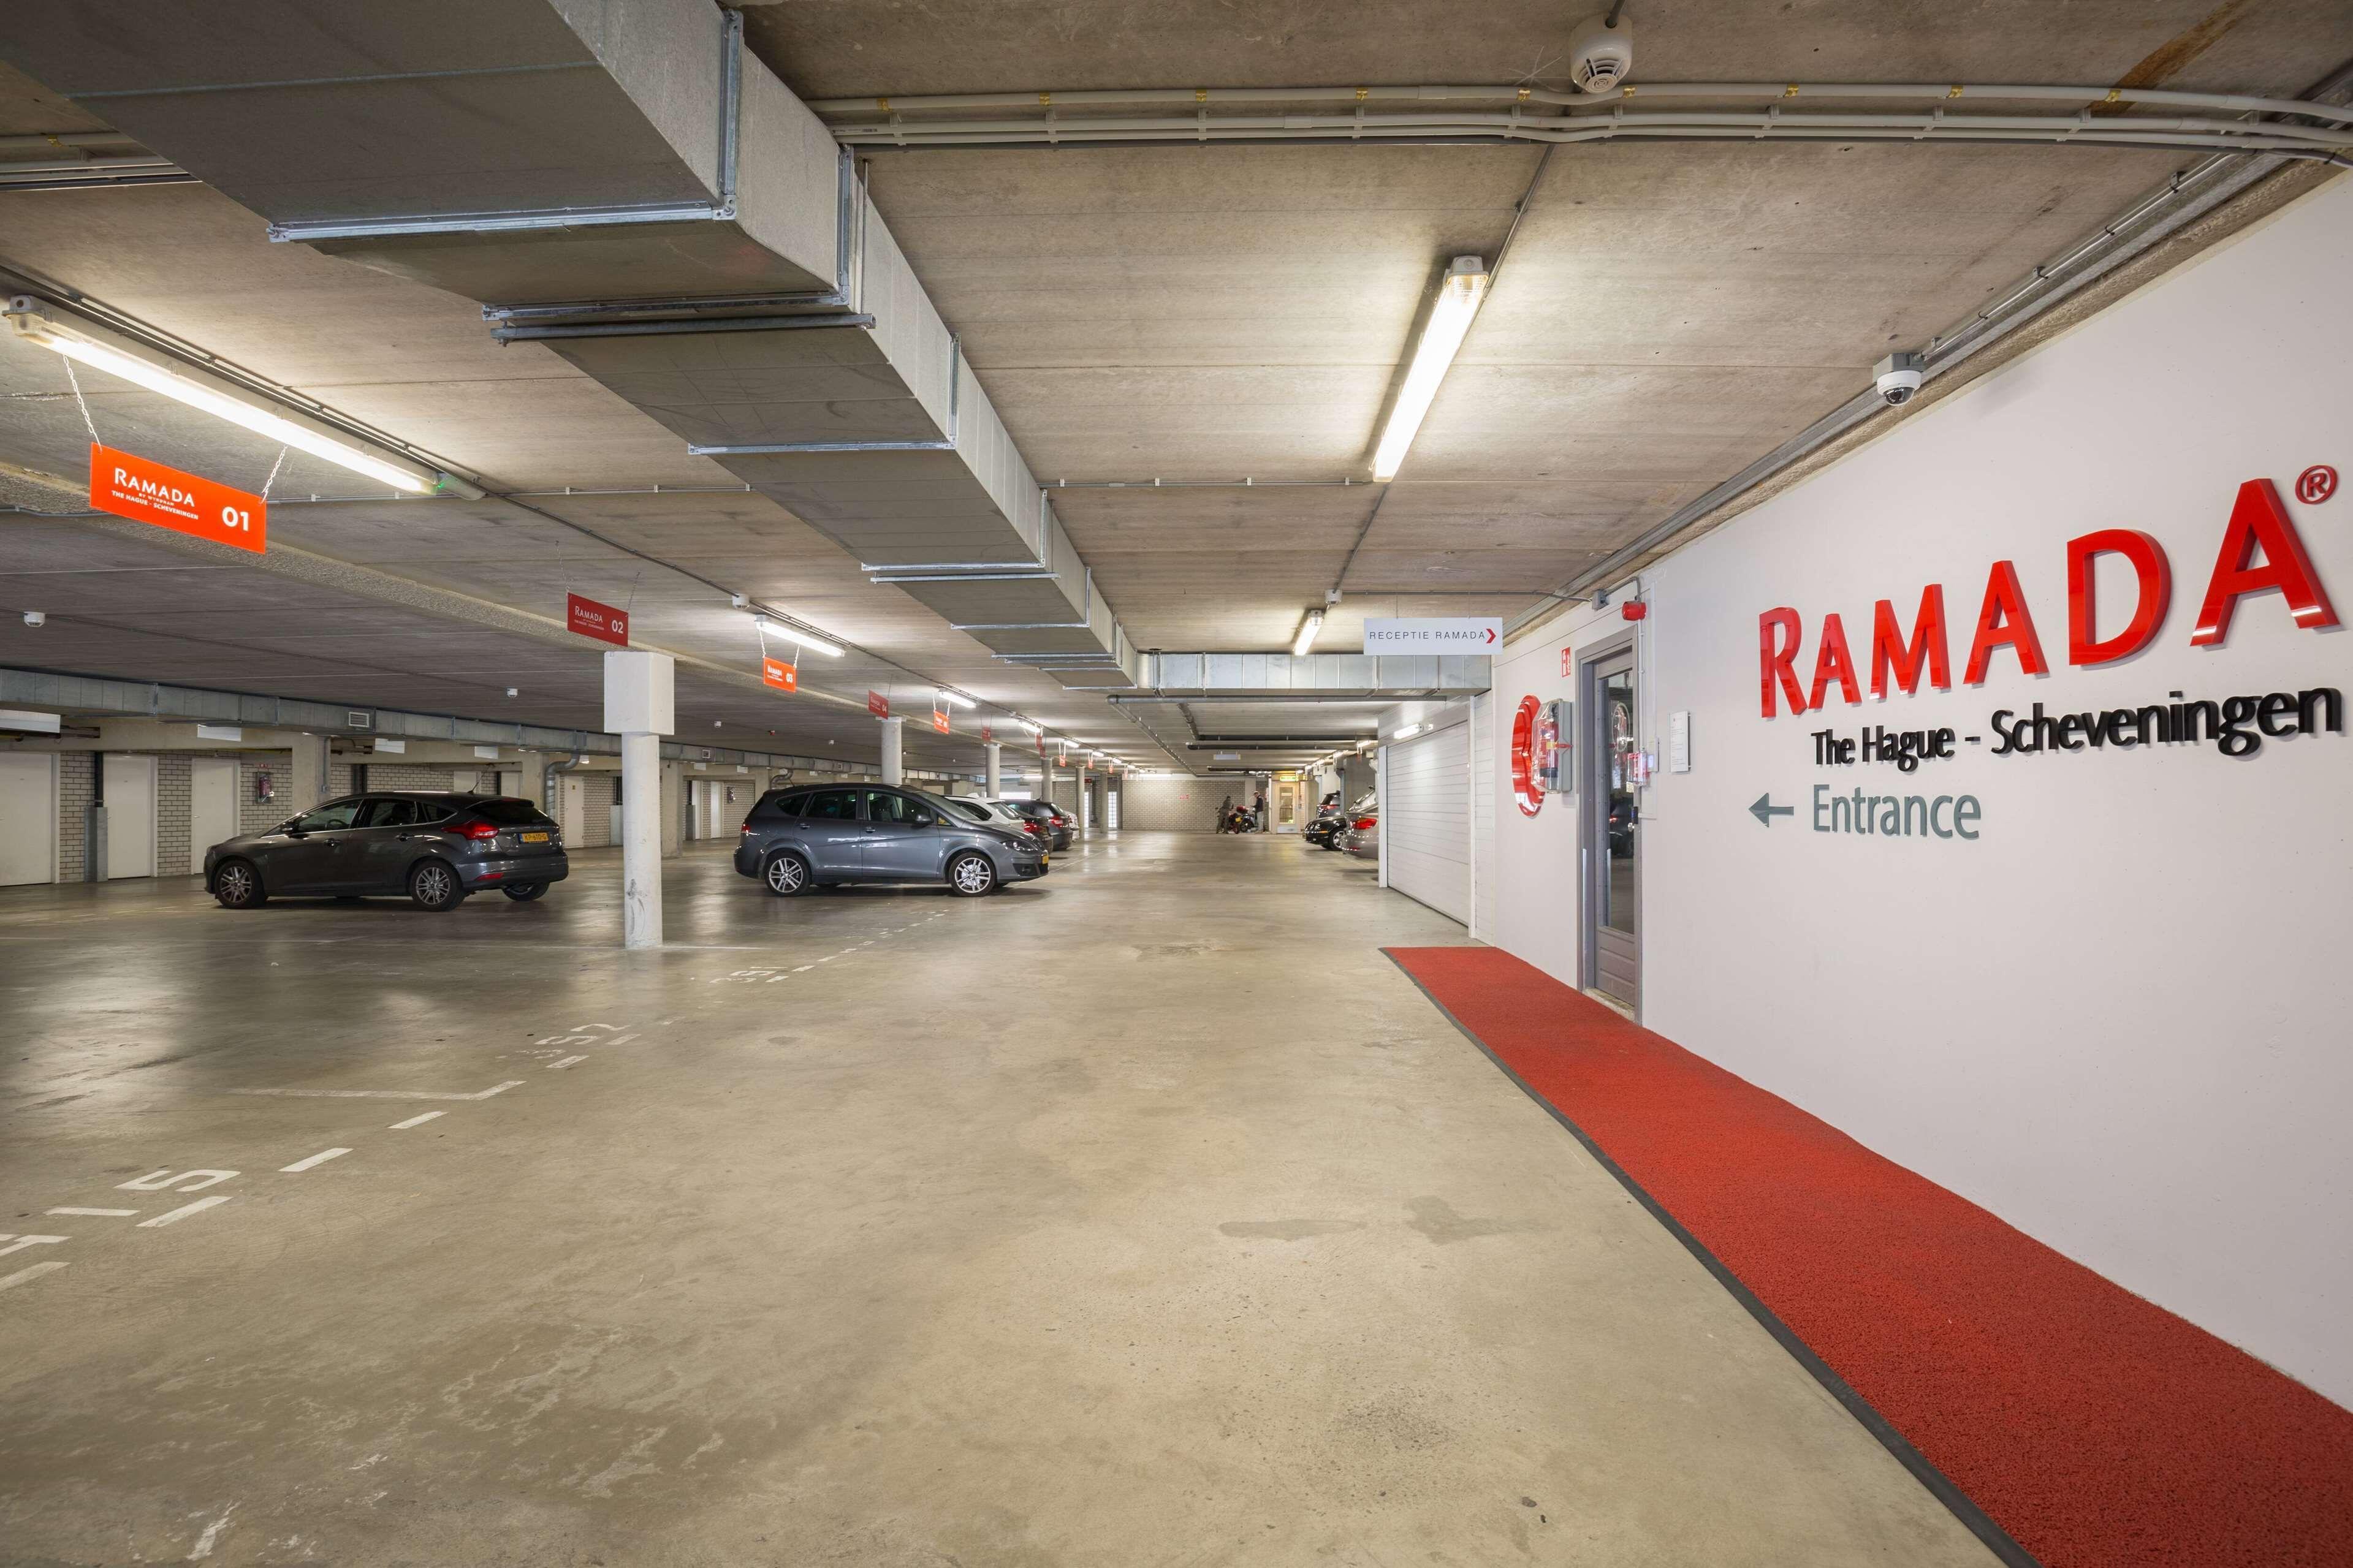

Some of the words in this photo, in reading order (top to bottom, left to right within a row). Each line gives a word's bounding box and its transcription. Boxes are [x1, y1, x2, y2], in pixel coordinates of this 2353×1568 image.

[115, 468, 195, 507] RAMADA
[112, 490, 124, 499] THE
[126, 494, 148, 506] HAGUE
[153, 502, 199, 520] SCHEVENINGEN
[222, 506, 249, 531] 01
[1758, 478, 2340, 718] RAMADA
[575, 605, 603, 623] RAMADA
[612, 619, 623, 634] 02
[1369, 631, 1429, 640] RECEPTIE
[1811, 728, 1855, 766] The
[1861, 725, 1955, 775] Hague
[1990, 687, 2343, 759] Scheveningen
[1813, 784, 1982, 840] Entrance
